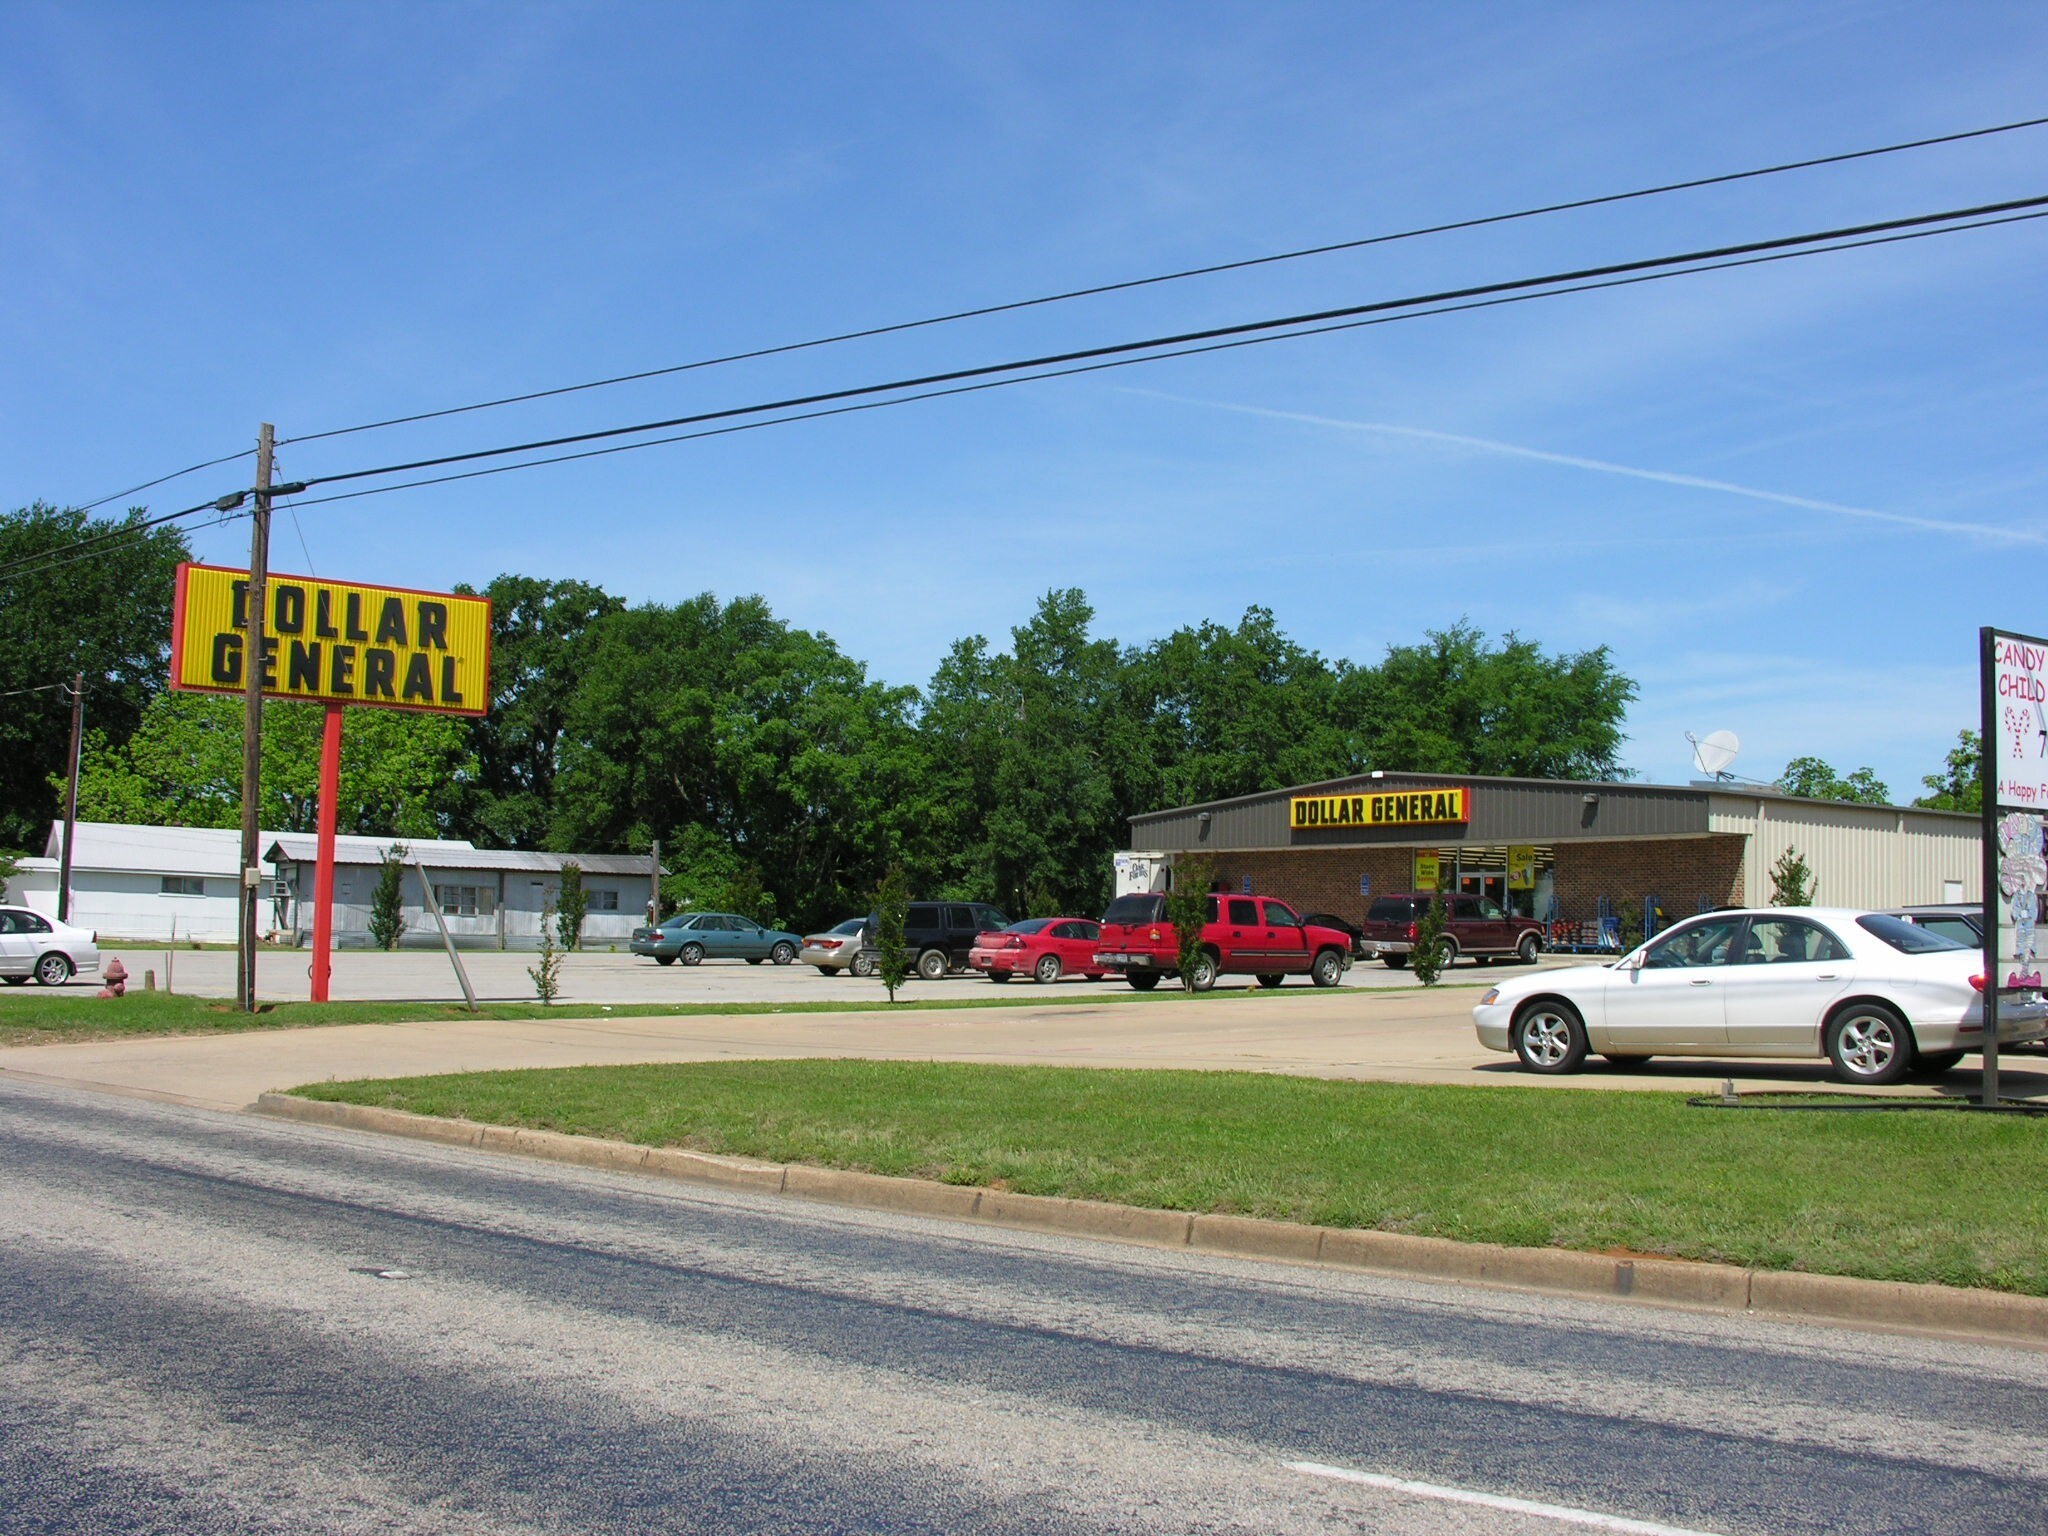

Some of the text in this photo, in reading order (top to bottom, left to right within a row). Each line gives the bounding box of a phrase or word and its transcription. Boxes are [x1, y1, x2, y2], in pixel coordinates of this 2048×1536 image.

[211, 632, 464, 703] GENERAL
[1994, 641, 2046, 672] CANDY
[1998, 673, 2046, 703] CHILD
[1997, 780, 2005, 794] A
[2008, 780, 2037, 803] Happy
[1295, 792, 1458, 825] DOLLAR GENERAL
[1516, 853, 1533, 862] Sale
